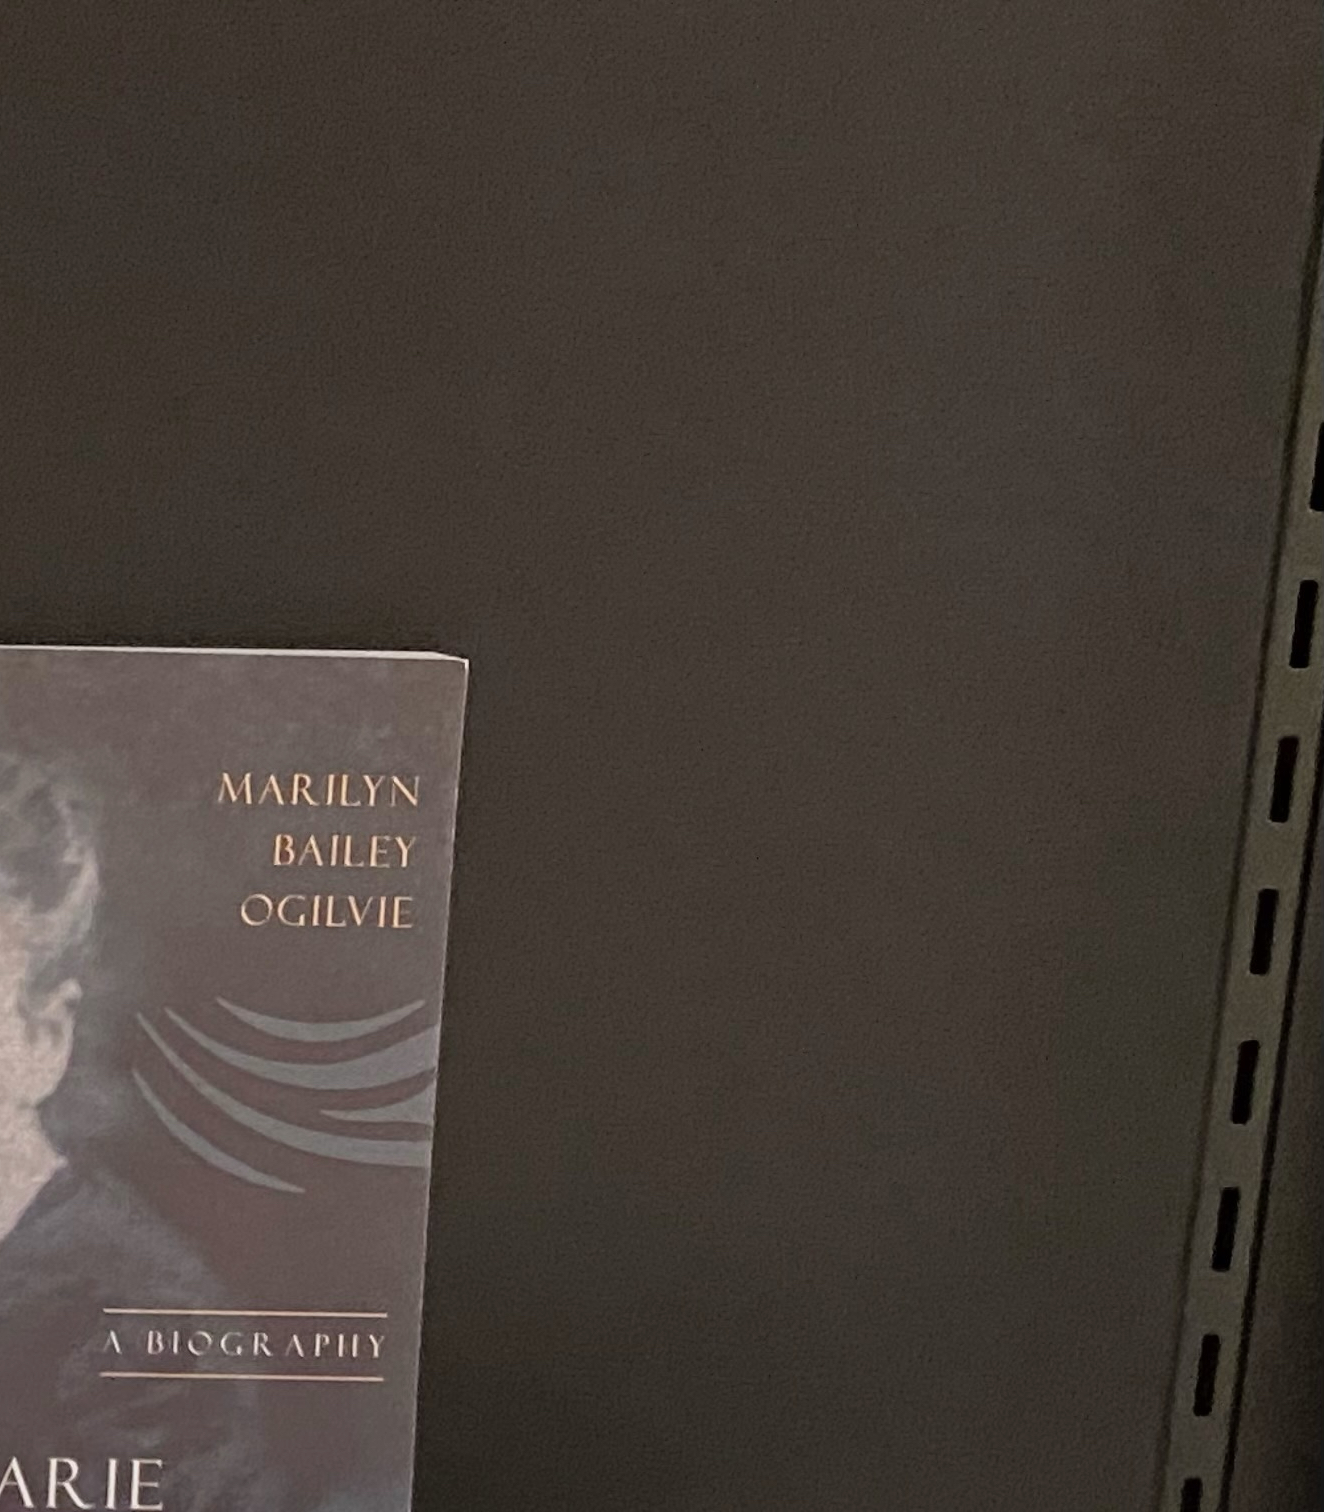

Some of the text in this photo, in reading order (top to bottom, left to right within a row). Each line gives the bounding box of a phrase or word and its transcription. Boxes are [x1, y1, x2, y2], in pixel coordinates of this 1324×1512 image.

[217, 771, 421, 808] MARILYN
[272, 836, 417, 870] BAILEY
[240, 893, 416, 929] OGILVIE
[103, 1330, 388, 1360] A BIOGRAPHY
